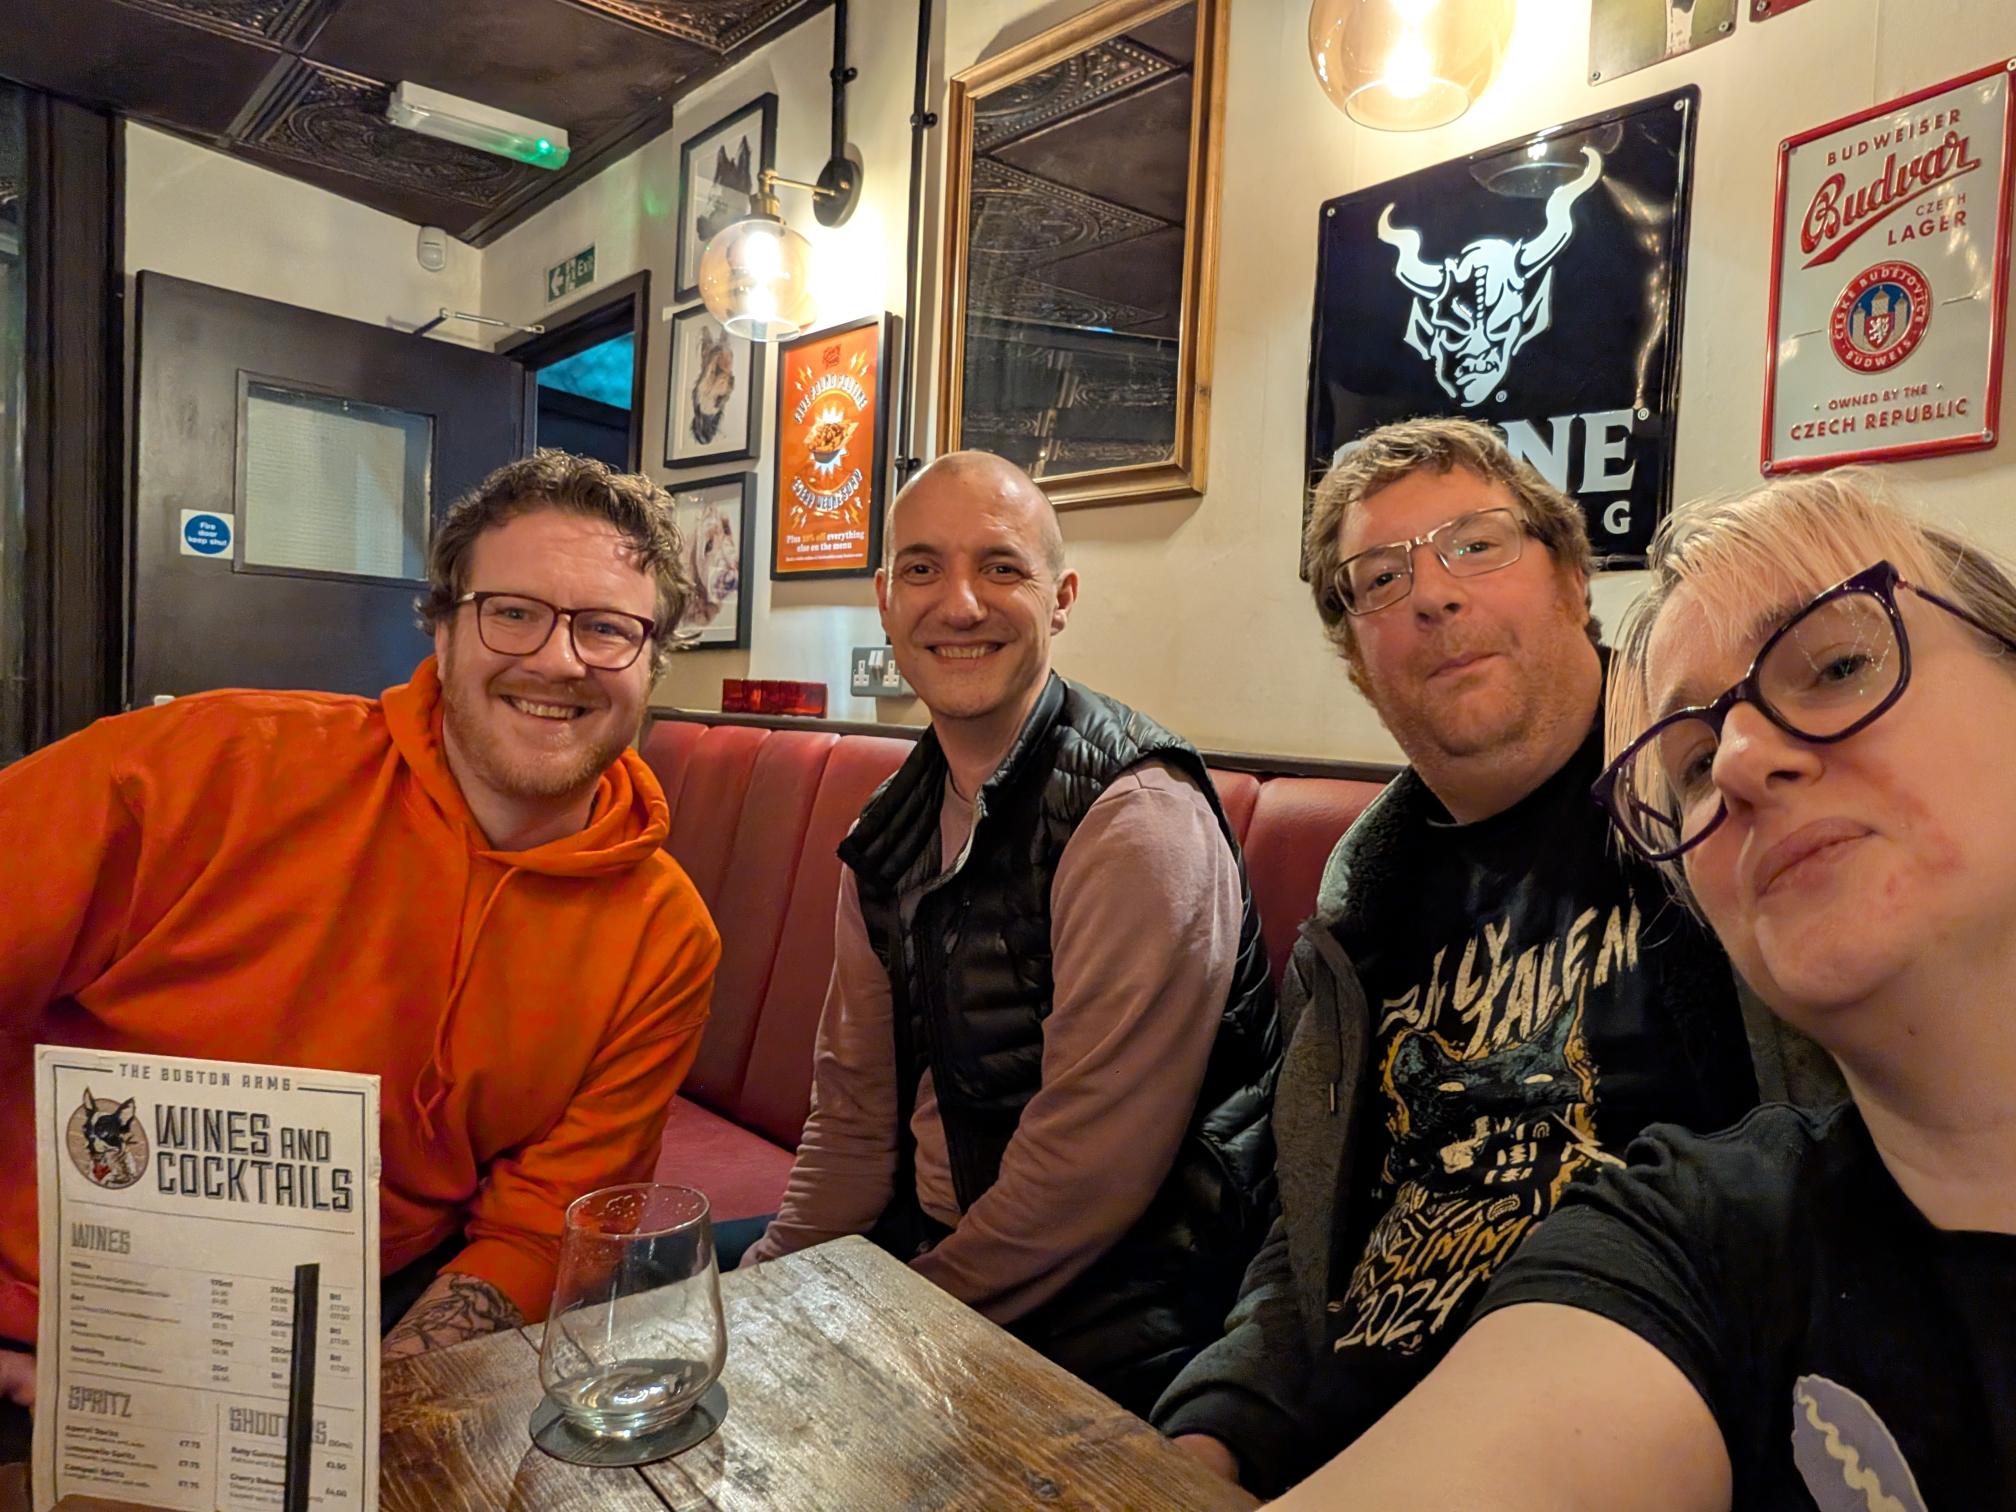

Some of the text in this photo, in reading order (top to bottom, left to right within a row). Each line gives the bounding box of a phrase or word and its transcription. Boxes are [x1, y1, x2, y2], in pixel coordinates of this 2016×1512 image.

[1827, 108, 1961, 167] BUDWEISER
[1800, 130, 1982, 254] Budvar
[1915, 192, 1967, 217] CZEH
[1887, 210, 1967, 246] LAGER
[1828, 384, 1928, 411] OWNED BY THE
[1790, 398, 1968, 441] CZECH REPUBLIC
[820, 542, 832, 550] the
[832, 541, 853, 550] menu
[827, 531, 865, 542] everything
[120, 1063, 292, 1092] THE BOSTON ARMS
[154, 1103, 331, 1163] WINES AND
[157, 1151, 353, 1214] COCKTAILS
[71, 1222, 130, 1254] WINES
[1334, 1266, 1480, 1352] 2024
[68, 1385, 132, 1418] SPRITZ
